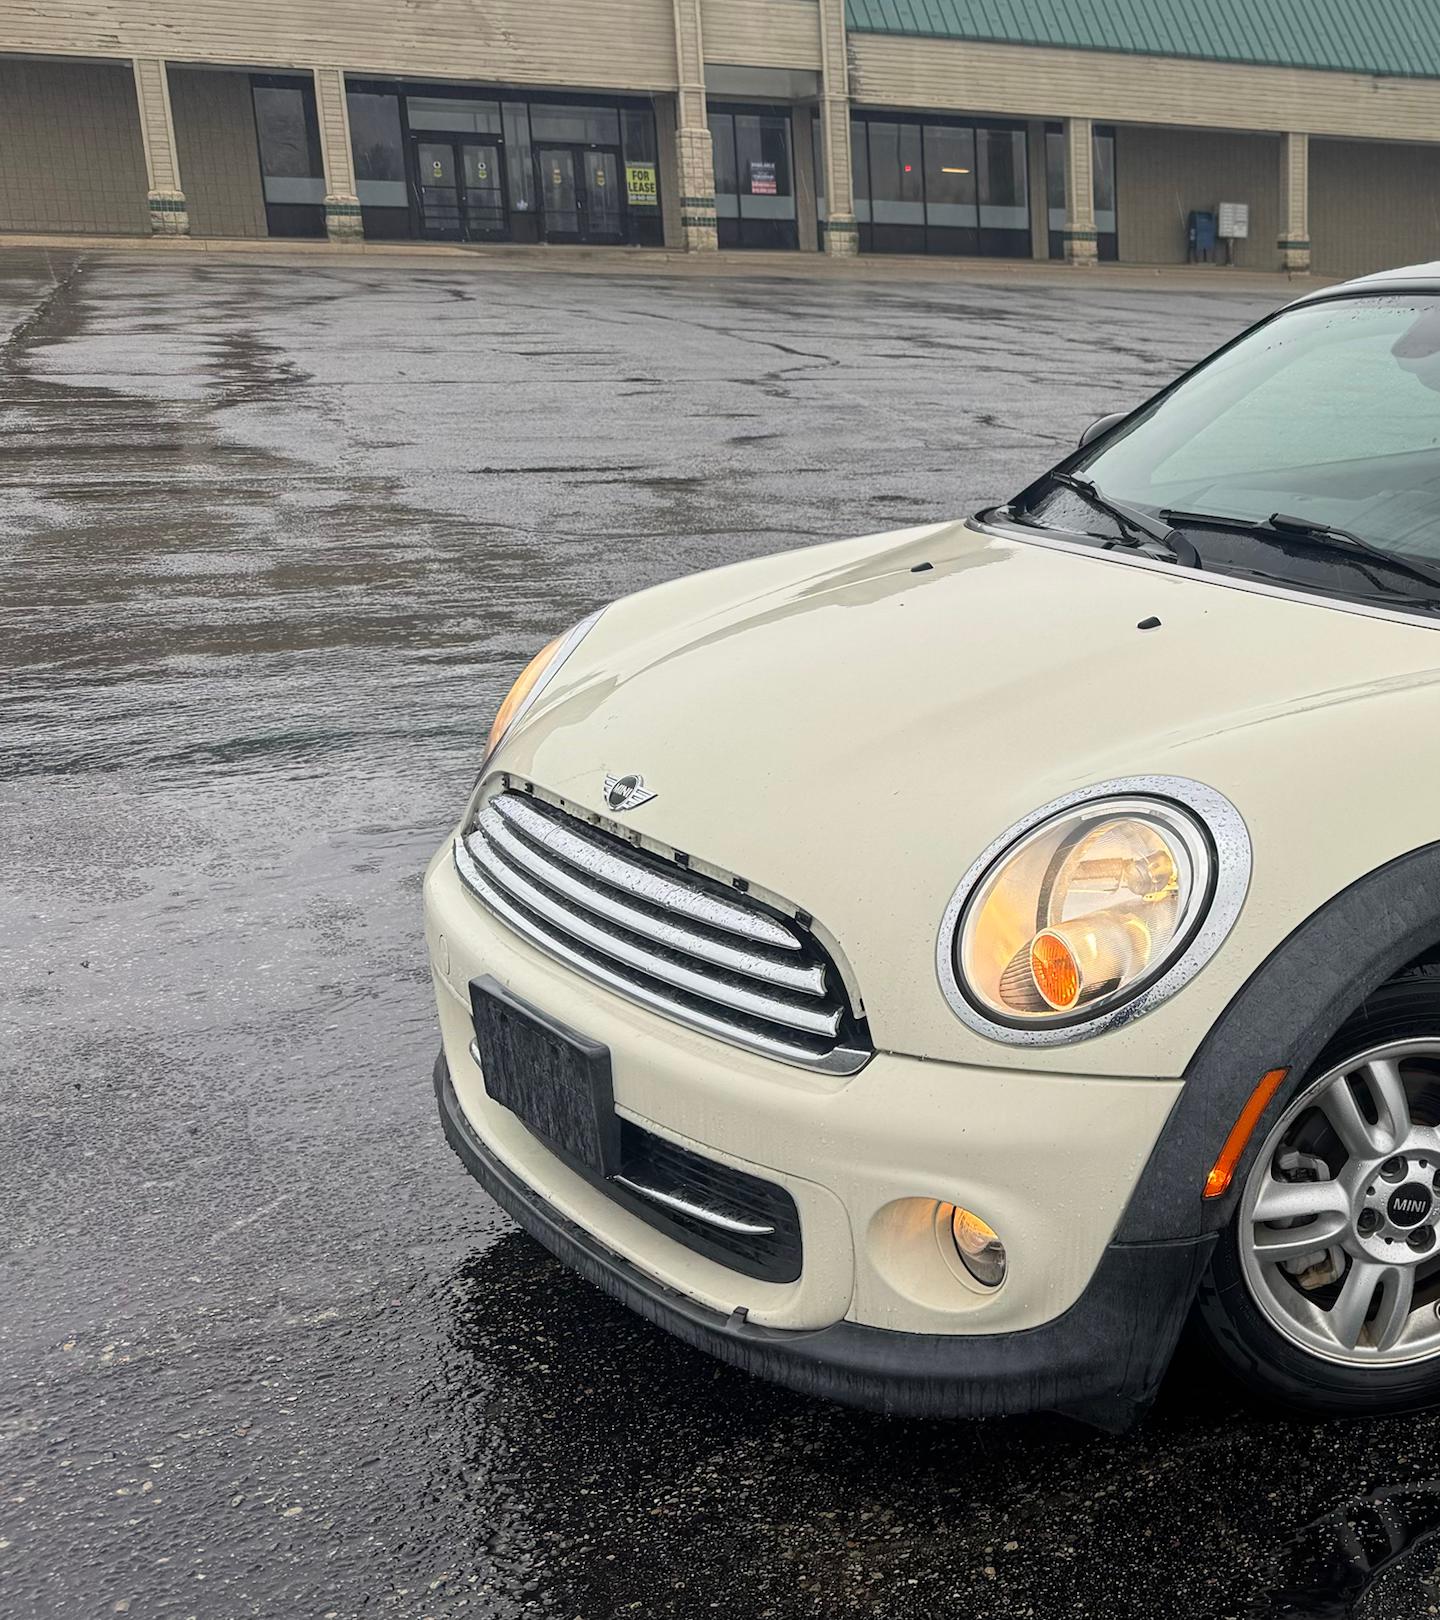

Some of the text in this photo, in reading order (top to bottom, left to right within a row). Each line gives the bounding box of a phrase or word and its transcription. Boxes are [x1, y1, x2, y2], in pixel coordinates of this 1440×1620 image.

[632, 170, 650, 181] FOR
[628, 182, 655, 193] LEASE
[613, 783, 634, 798] MINI
[1393, 1197, 1426, 1213] MINI
